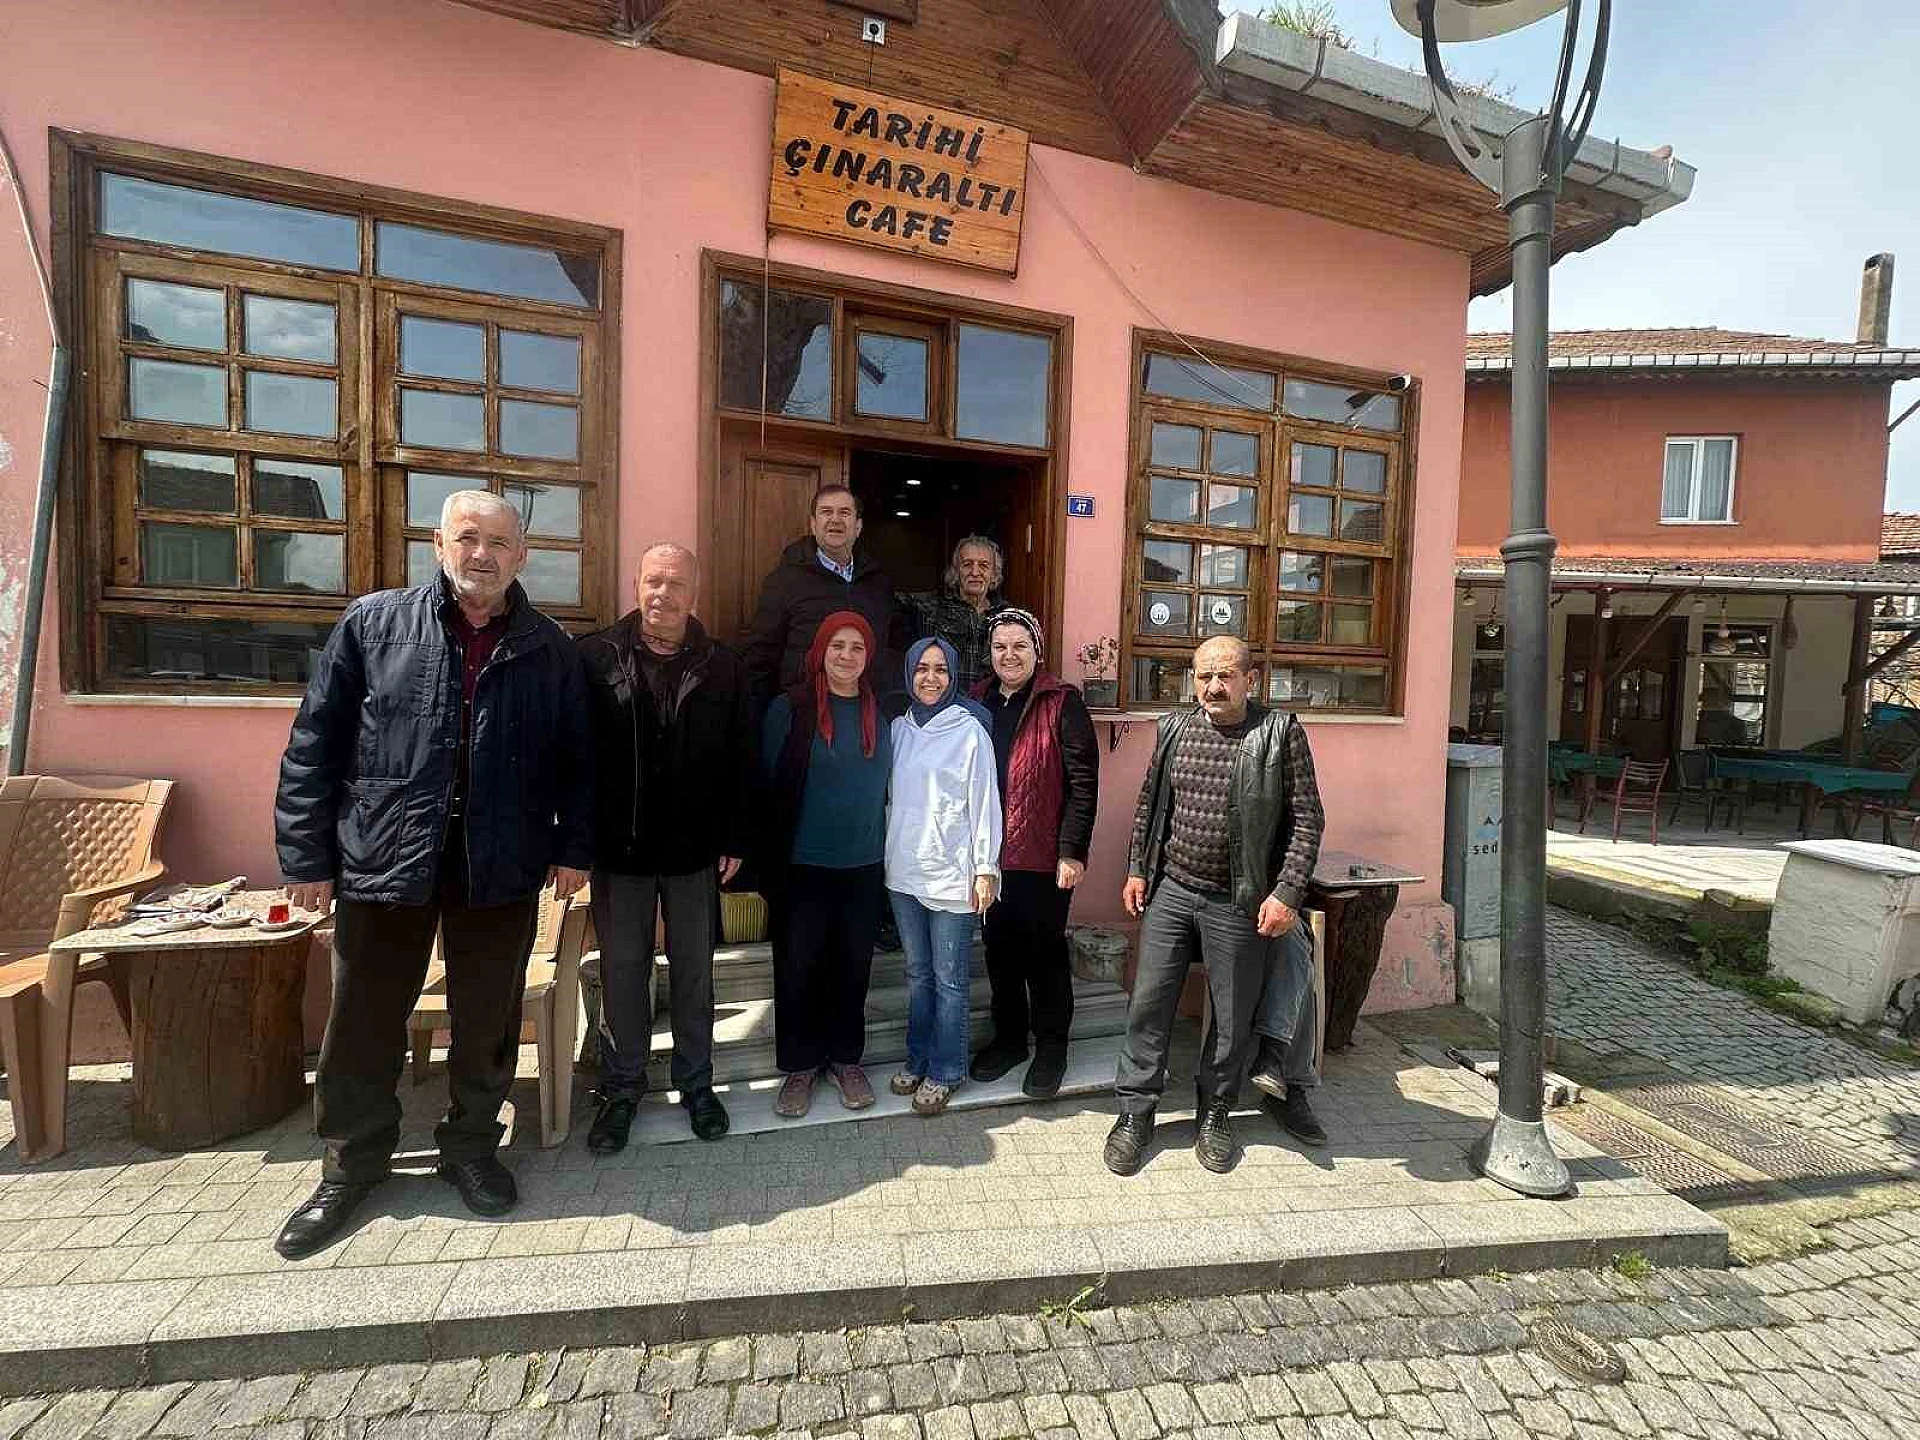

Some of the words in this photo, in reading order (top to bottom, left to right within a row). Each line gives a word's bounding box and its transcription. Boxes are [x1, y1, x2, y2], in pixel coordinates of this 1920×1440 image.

[832, 99, 984, 162] TARİHİ
[785, 138, 1017, 216] ÇINARALTI
[845, 199, 954, 246] CAFE
